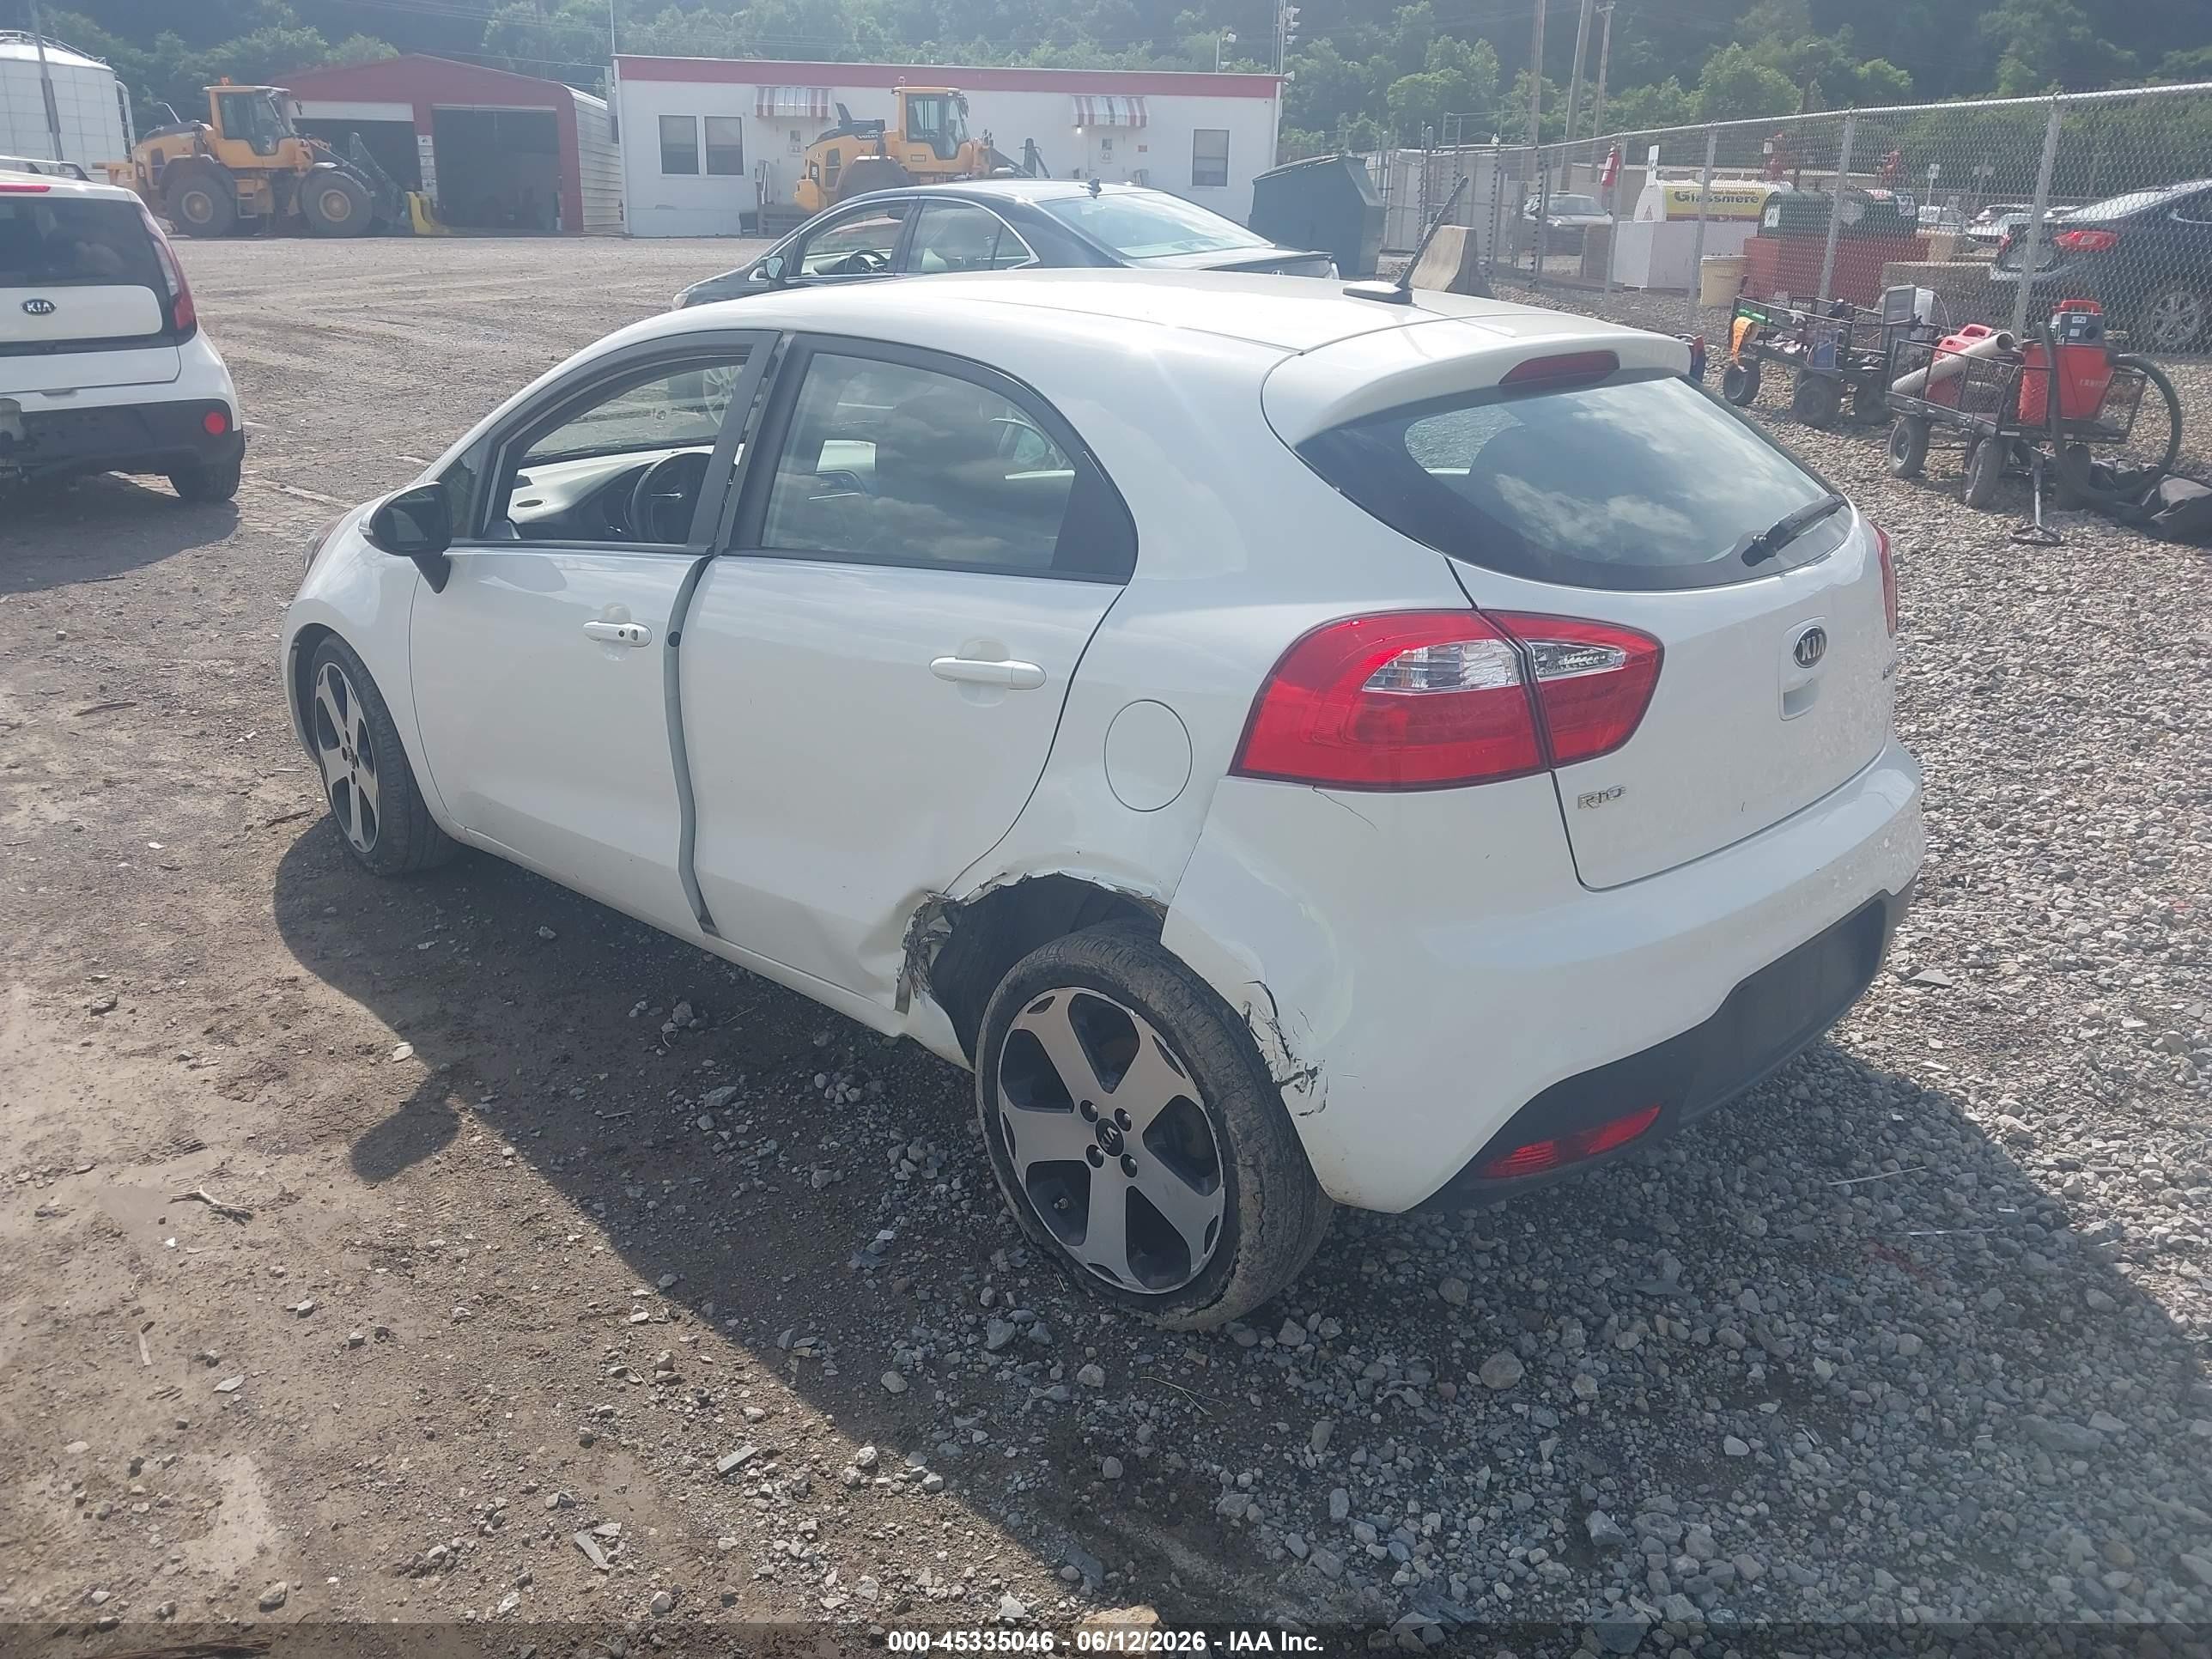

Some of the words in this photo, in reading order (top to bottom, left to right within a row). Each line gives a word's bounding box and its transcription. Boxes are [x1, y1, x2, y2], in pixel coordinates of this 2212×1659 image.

[1674, 191, 1759, 203] Glassmere
[26, 301, 52, 312] KIA
[1801, 633, 1825, 660] KIA
[1577, 784, 1626, 810] RIO
[1100, 1127, 1119, 1152] KIA
